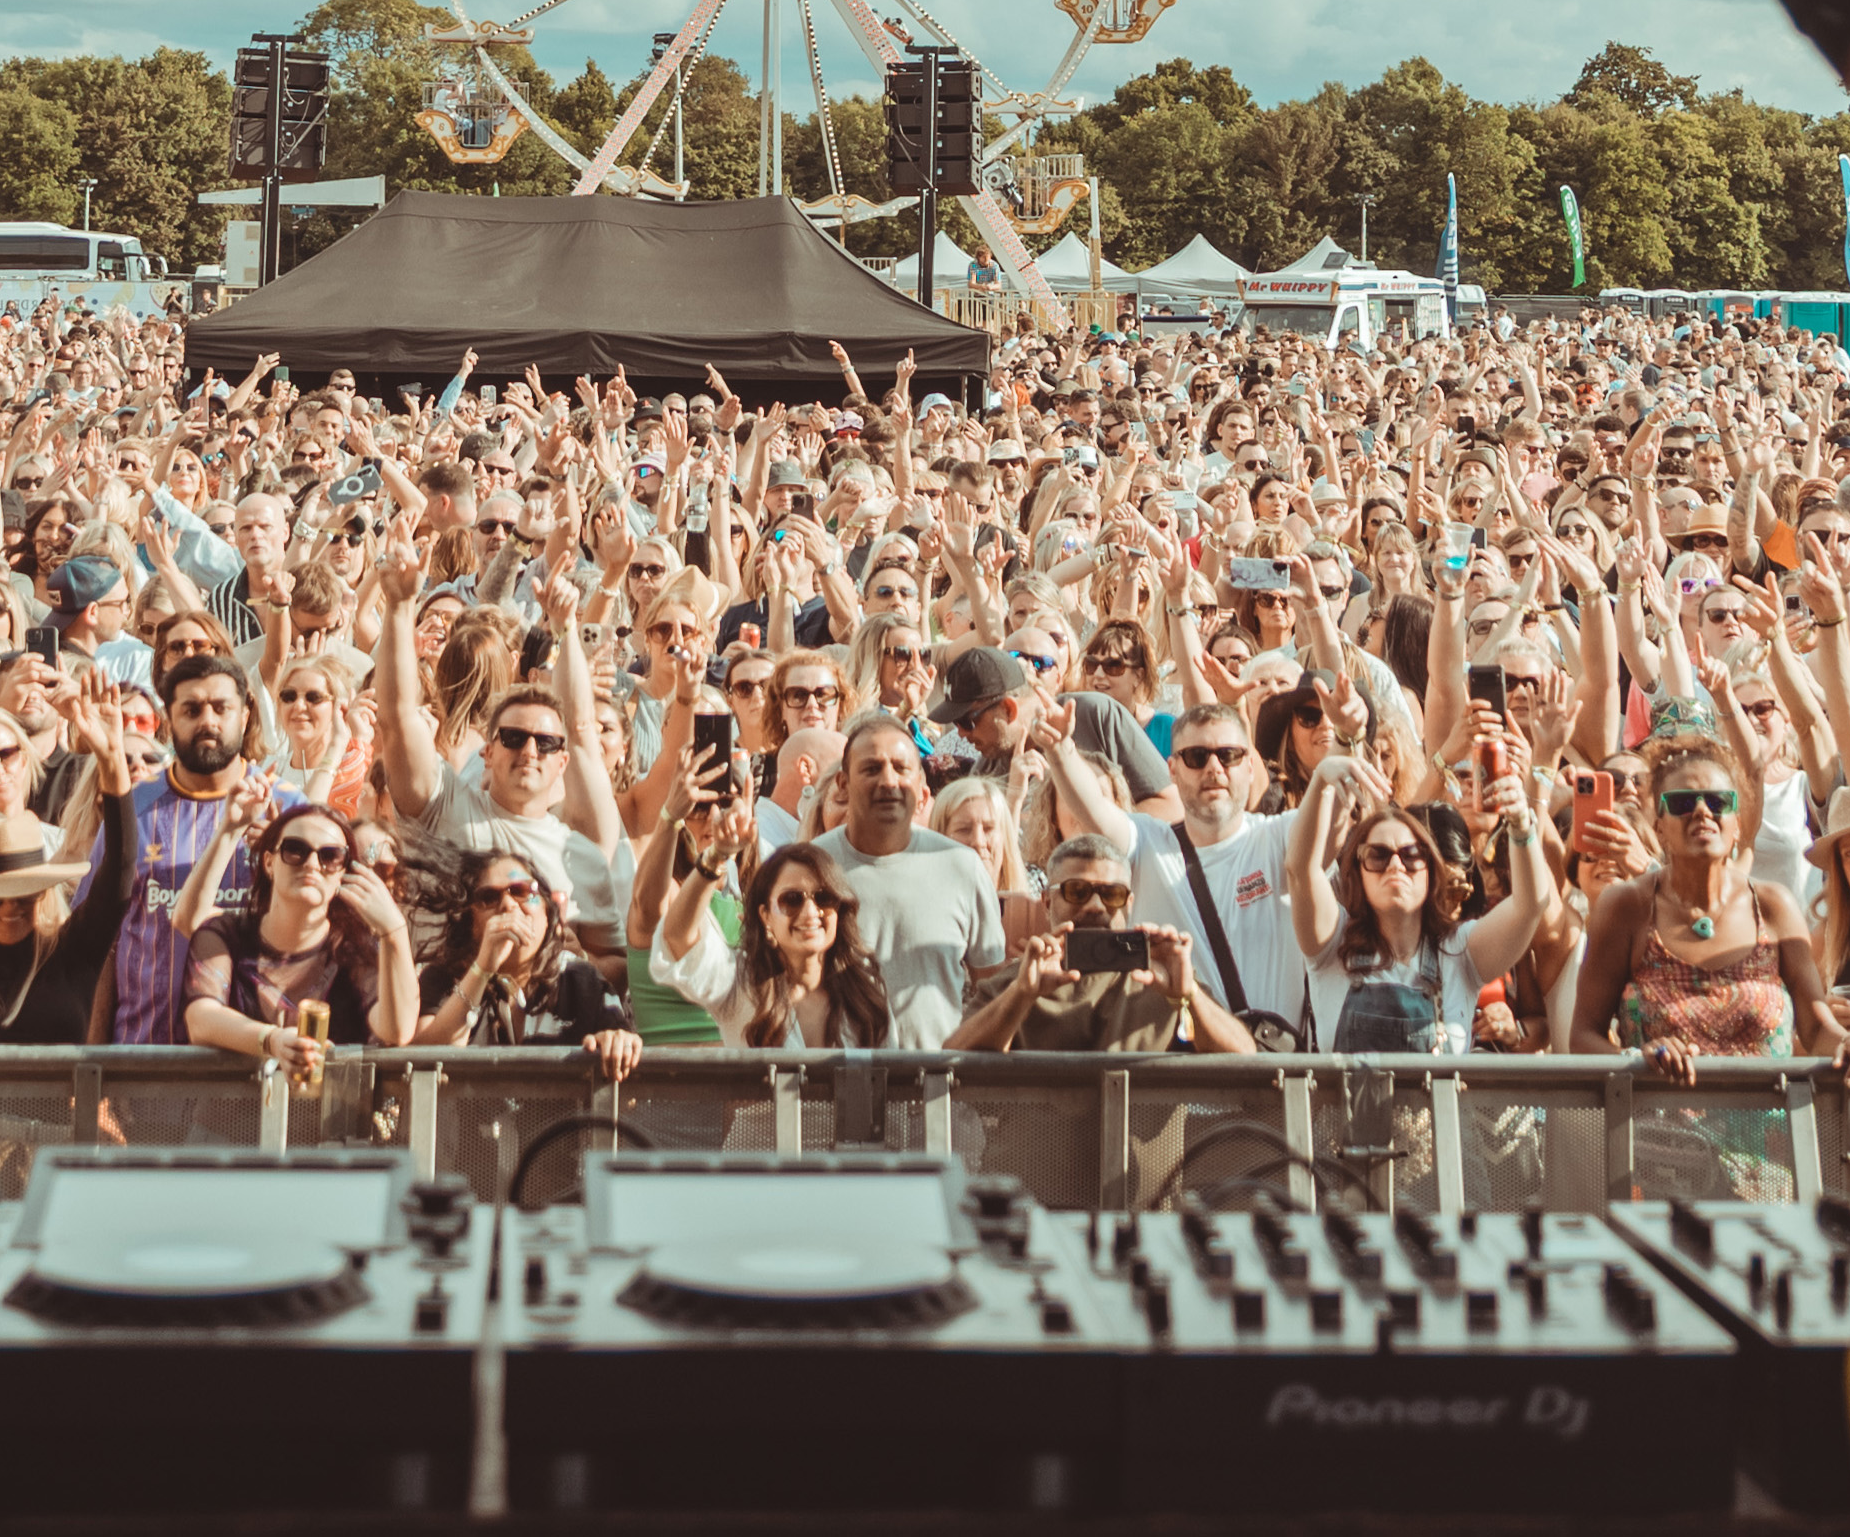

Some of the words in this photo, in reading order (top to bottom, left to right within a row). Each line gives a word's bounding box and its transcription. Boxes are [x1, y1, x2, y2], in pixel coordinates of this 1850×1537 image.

[1081, 4, 1094, 14] 10
[438, 122, 445, 132] 6
[1270, 281, 1328, 293] WHIPPY
[1266, 1383, 1509, 1426] Pioneer
